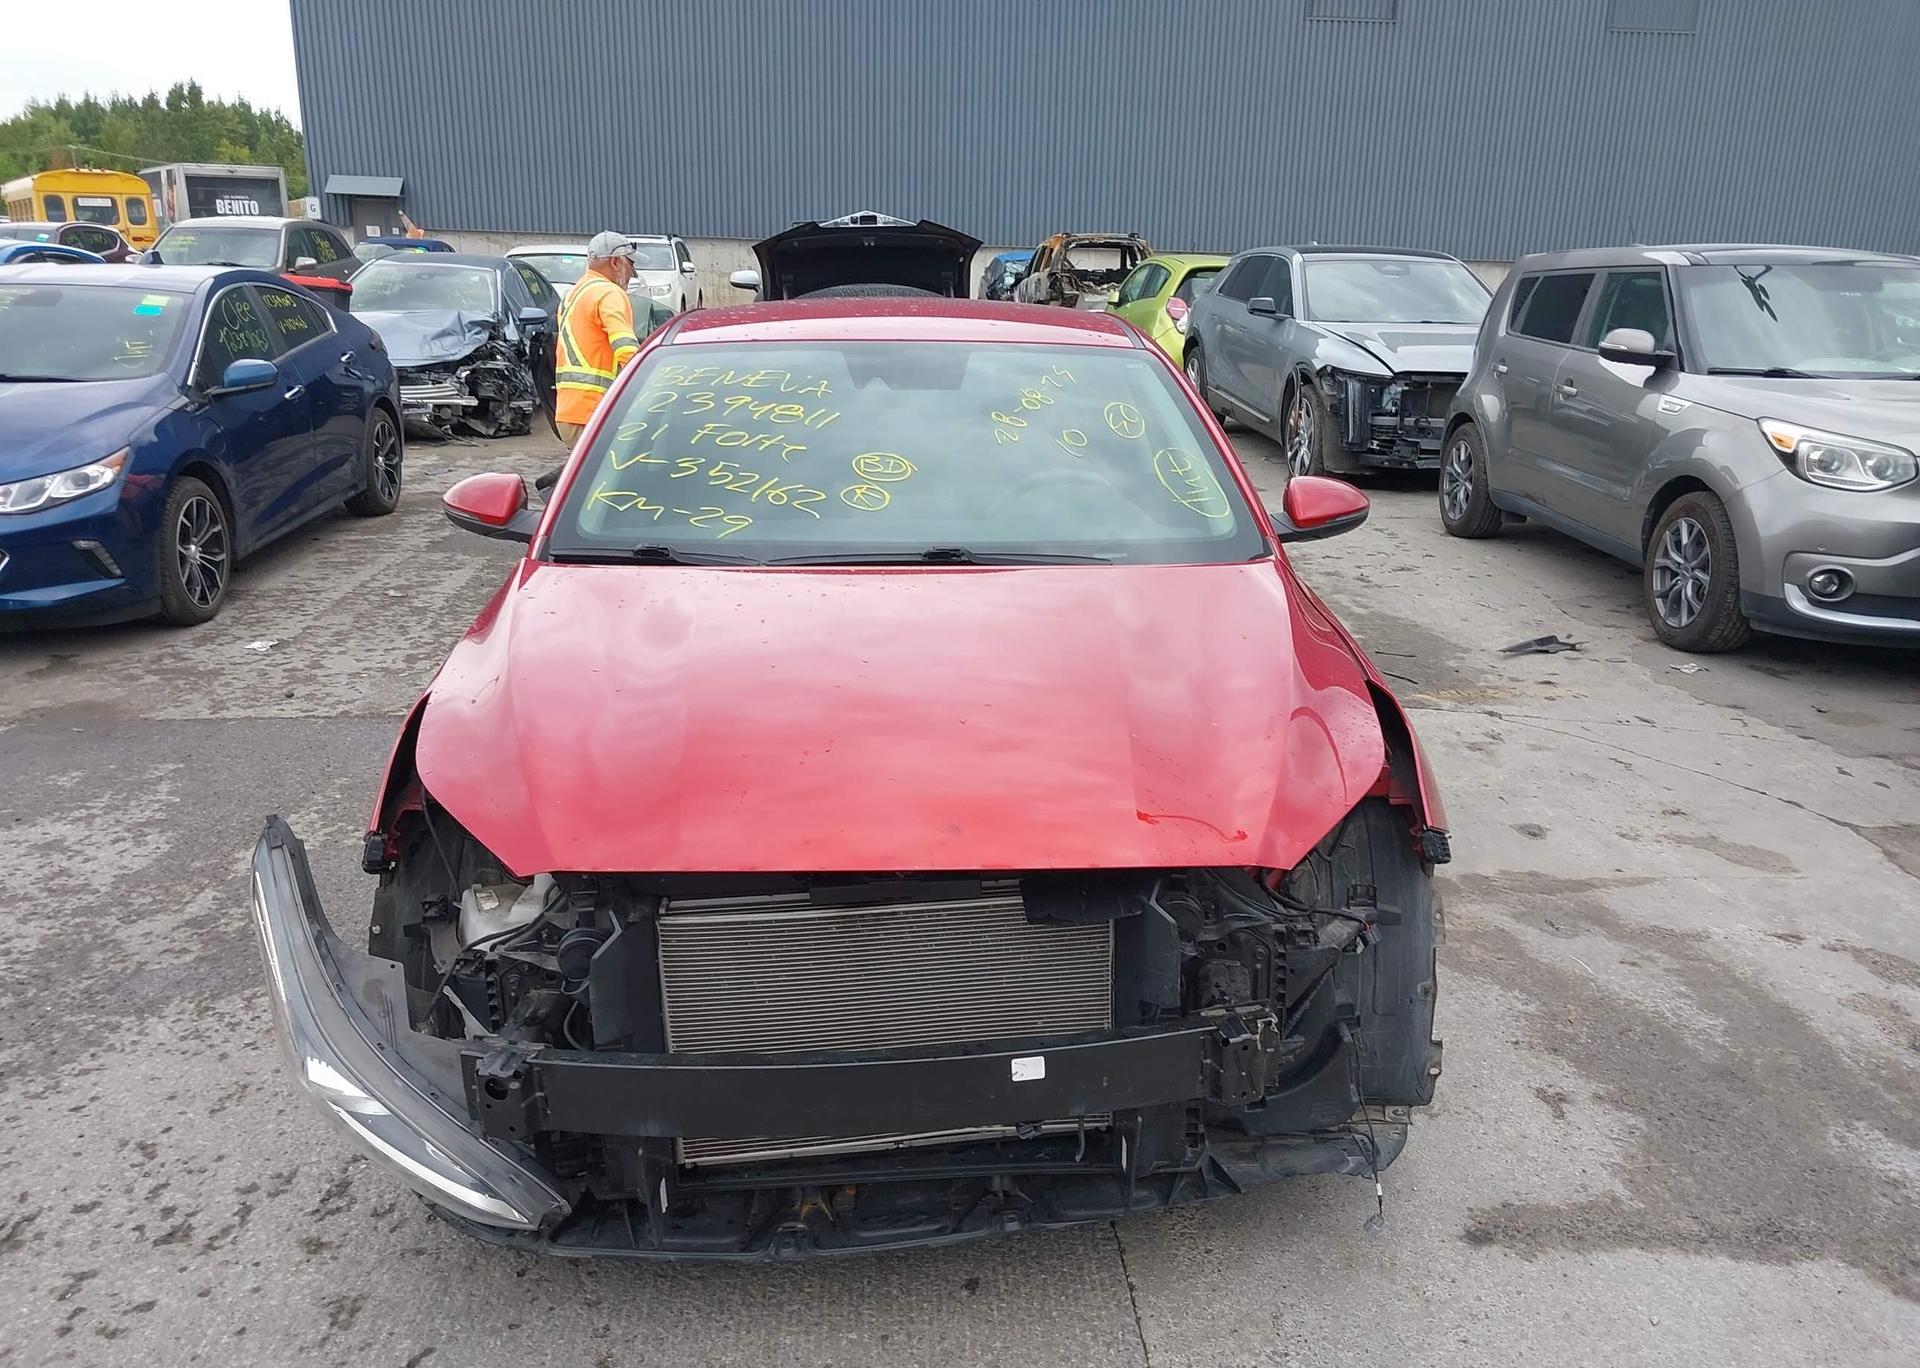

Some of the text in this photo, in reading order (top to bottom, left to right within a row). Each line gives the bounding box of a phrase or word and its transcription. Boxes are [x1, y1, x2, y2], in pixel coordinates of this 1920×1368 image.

[215, 198, 260, 215] BENITO
[310, 203, 316, 213] G
[651, 365, 834, 399] BENEVA
[647, 391, 841, 430] 2394811
[615, 421, 669, 442] 21
[1055, 428, 1088, 458] 10
